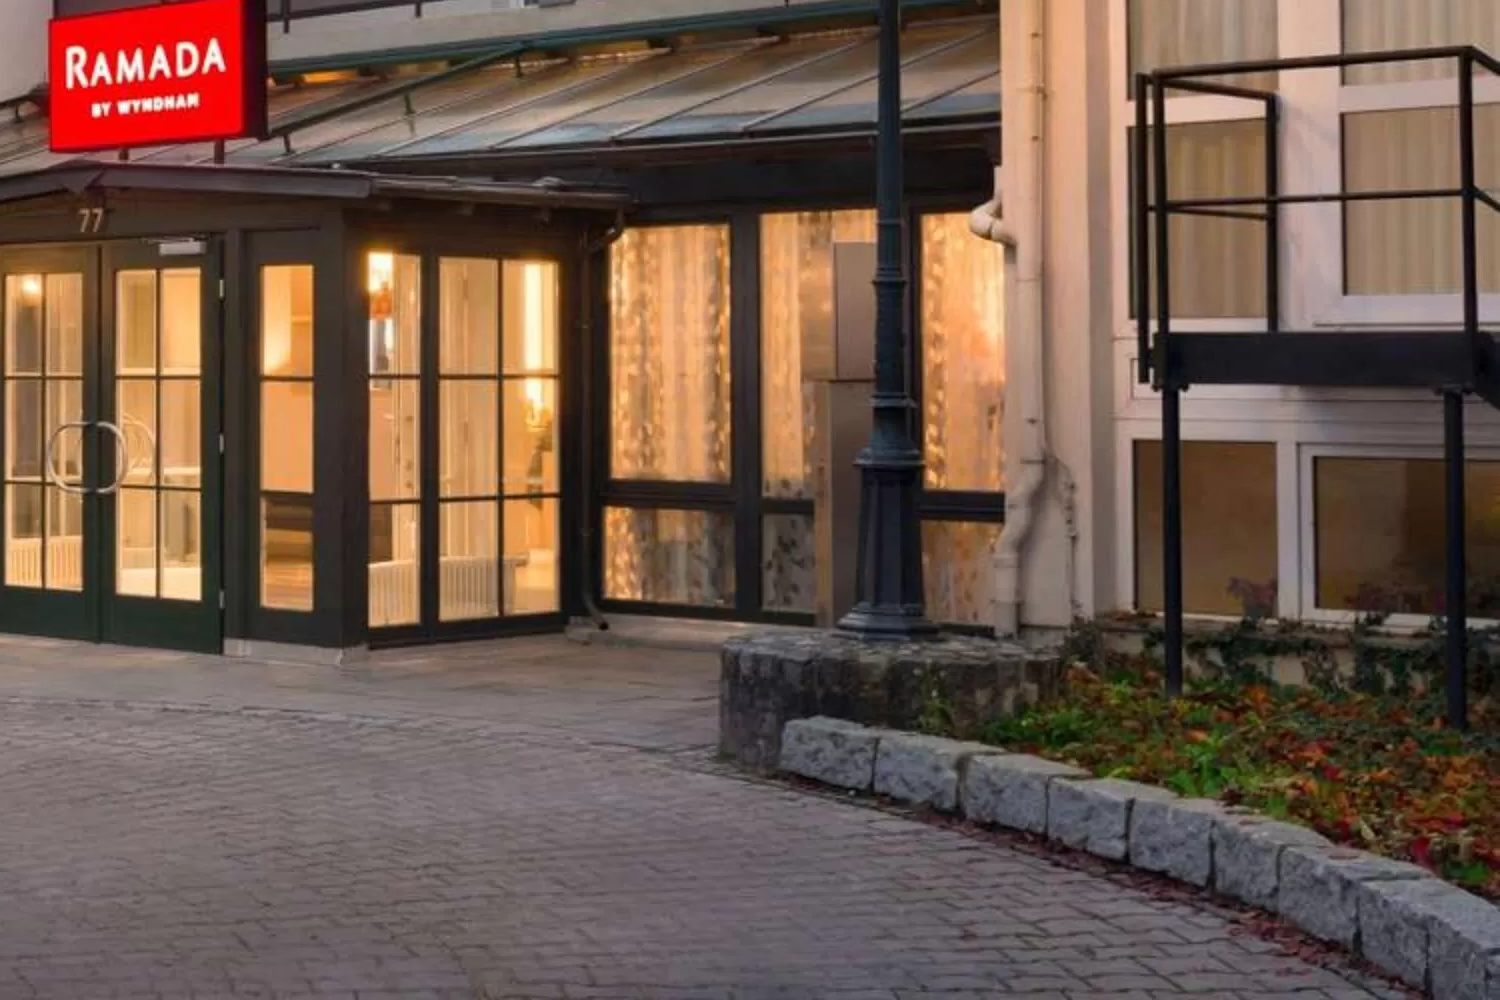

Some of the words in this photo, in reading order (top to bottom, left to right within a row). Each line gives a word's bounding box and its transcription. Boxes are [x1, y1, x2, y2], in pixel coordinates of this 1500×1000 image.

[65, 37, 226, 89] RAMADA
[91, 102, 111, 118] BY
[117, 93, 199, 115] WYNDHAM
[80, 208, 104, 233] 77
